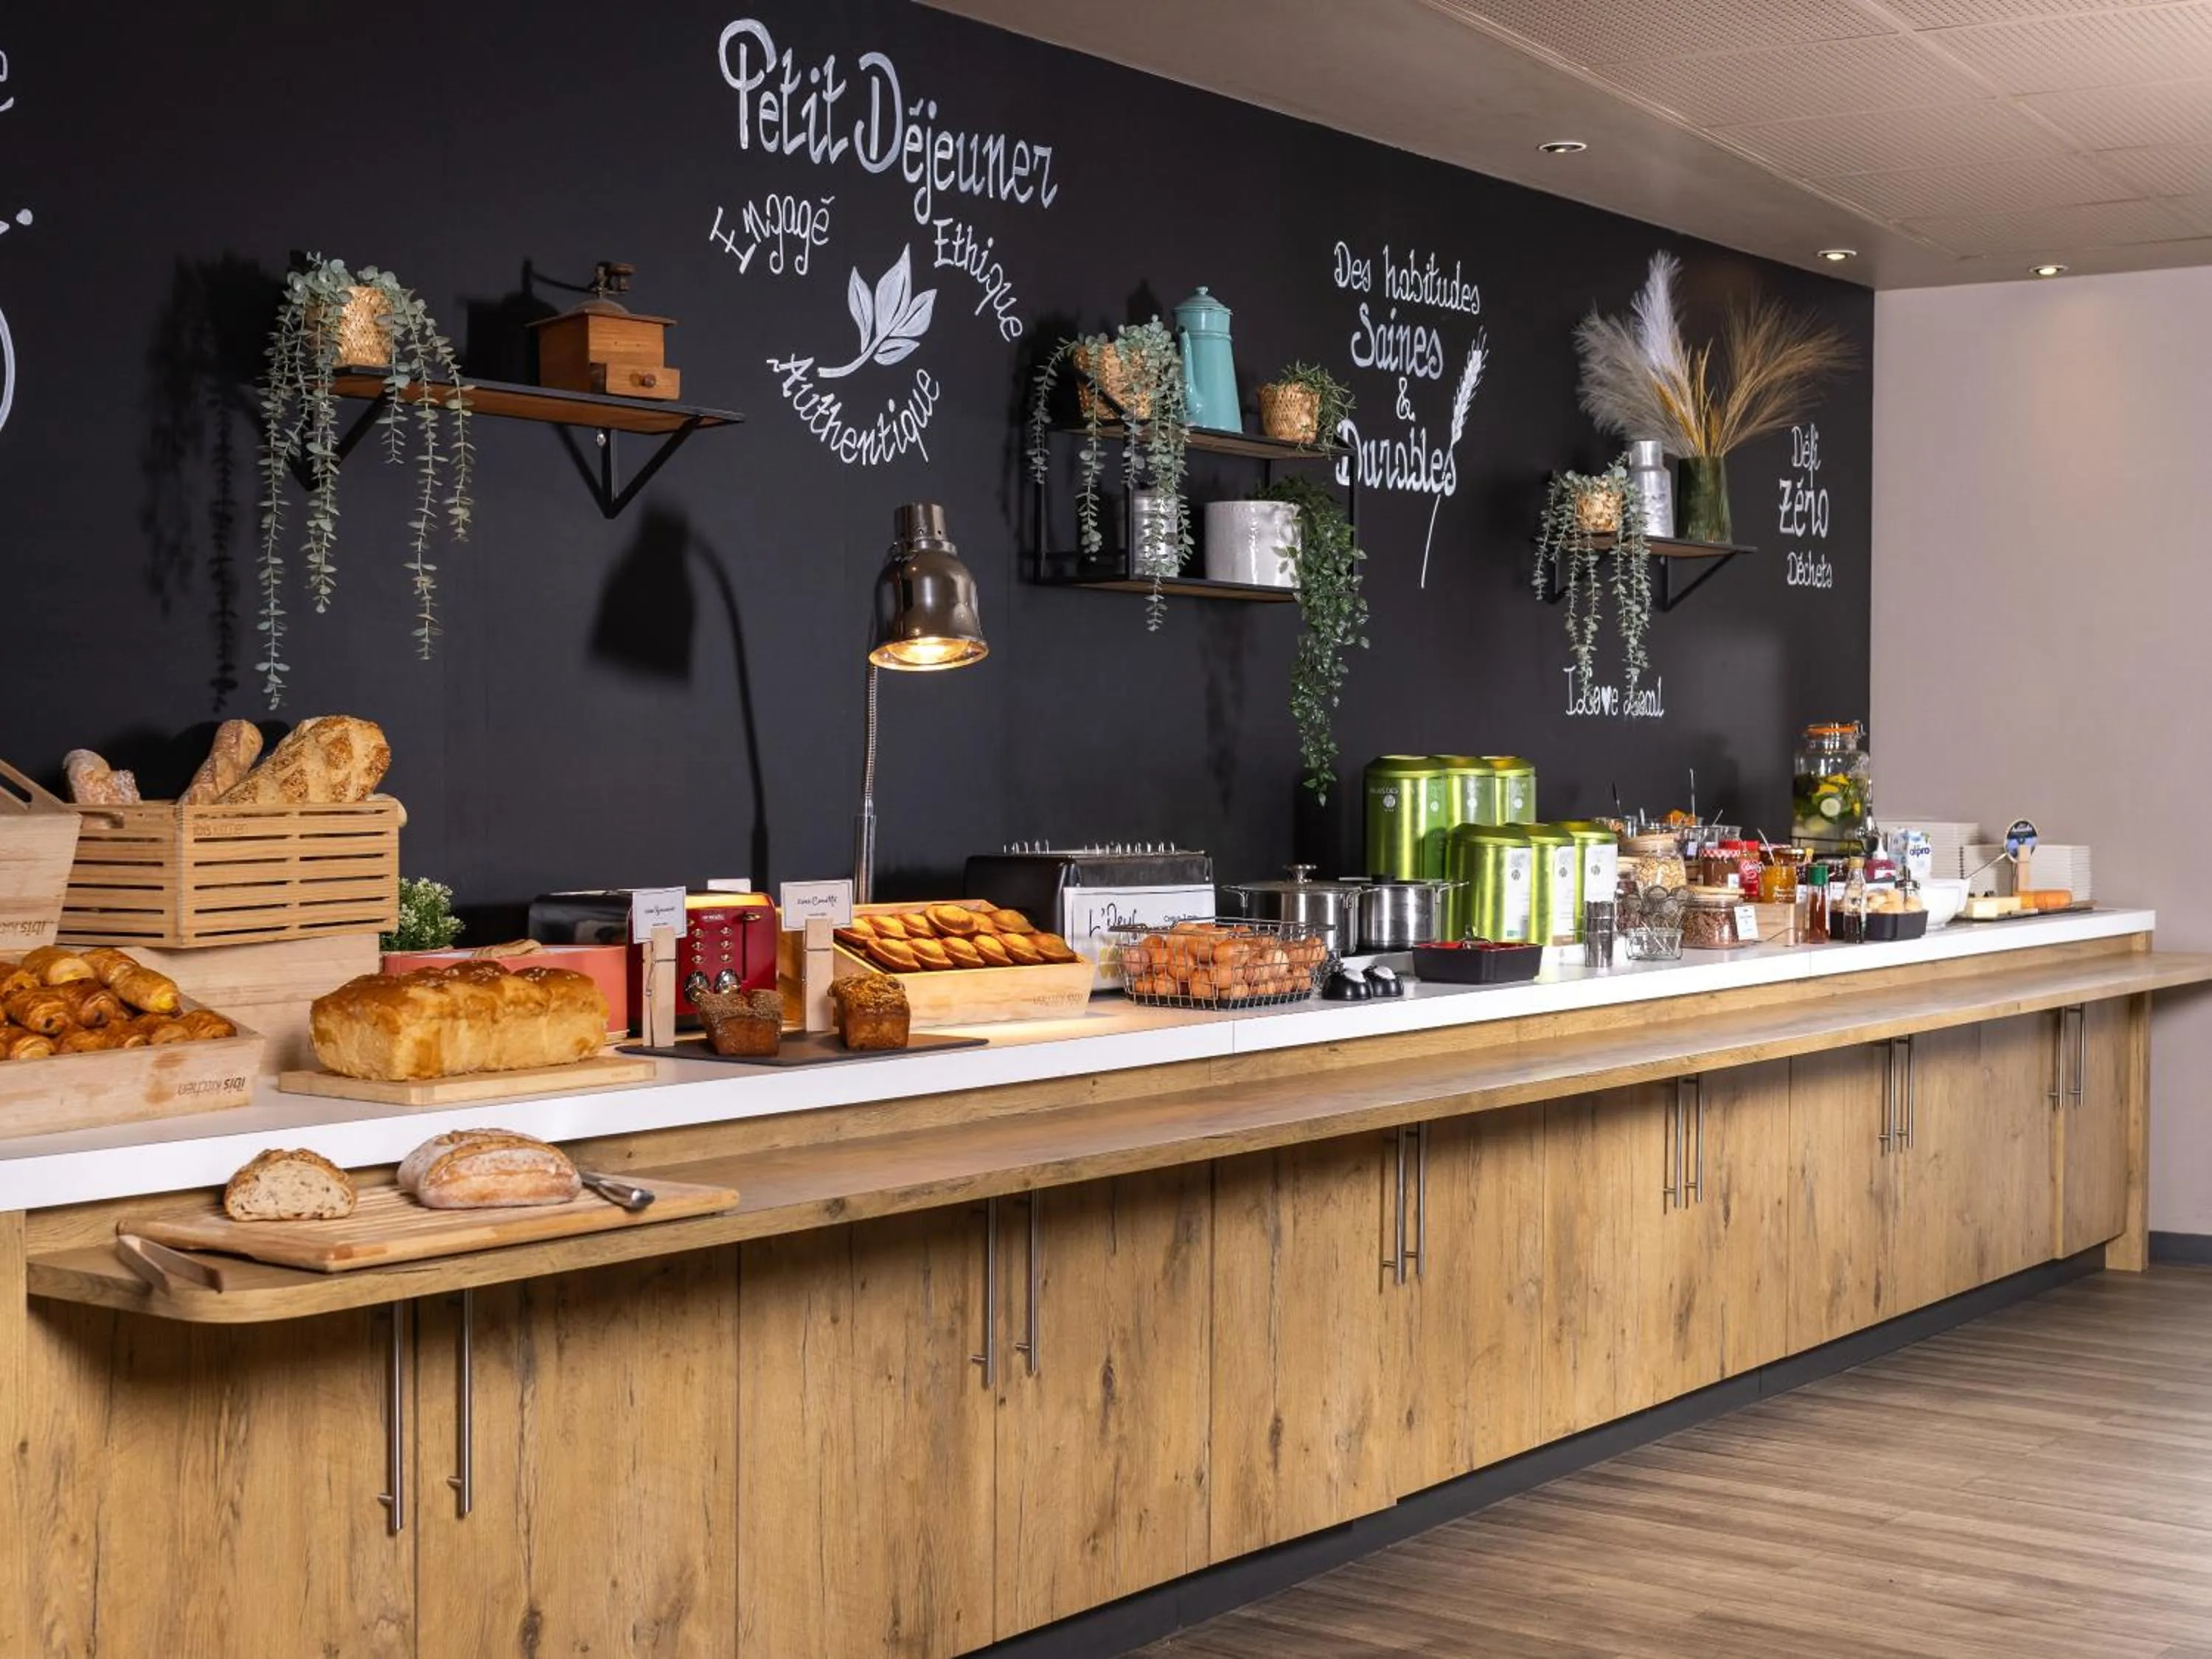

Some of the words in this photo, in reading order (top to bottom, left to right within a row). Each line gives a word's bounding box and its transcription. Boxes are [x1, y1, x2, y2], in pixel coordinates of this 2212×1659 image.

[718, 18, 848, 164] Petit
[855, 52, 1059, 224] Déjeuner
[709, 194, 835, 275] Engagé
[933, 218, 1023, 341] Ethique
[1335, 241, 1371, 293] Des
[1383, 244, 1480, 314] habitudes
[1351, 302, 1443, 380] Saines
[767, 354, 939, 465] Authentique
[1397, 377, 1415, 421] &
[1335, 419, 1456, 496] Durables
[1792, 423, 1821, 488] Défi
[1779, 477, 1829, 538] Zéro
[1787, 551, 1832, 588] Déchets
[1910, 844, 1930, 858] alpro
